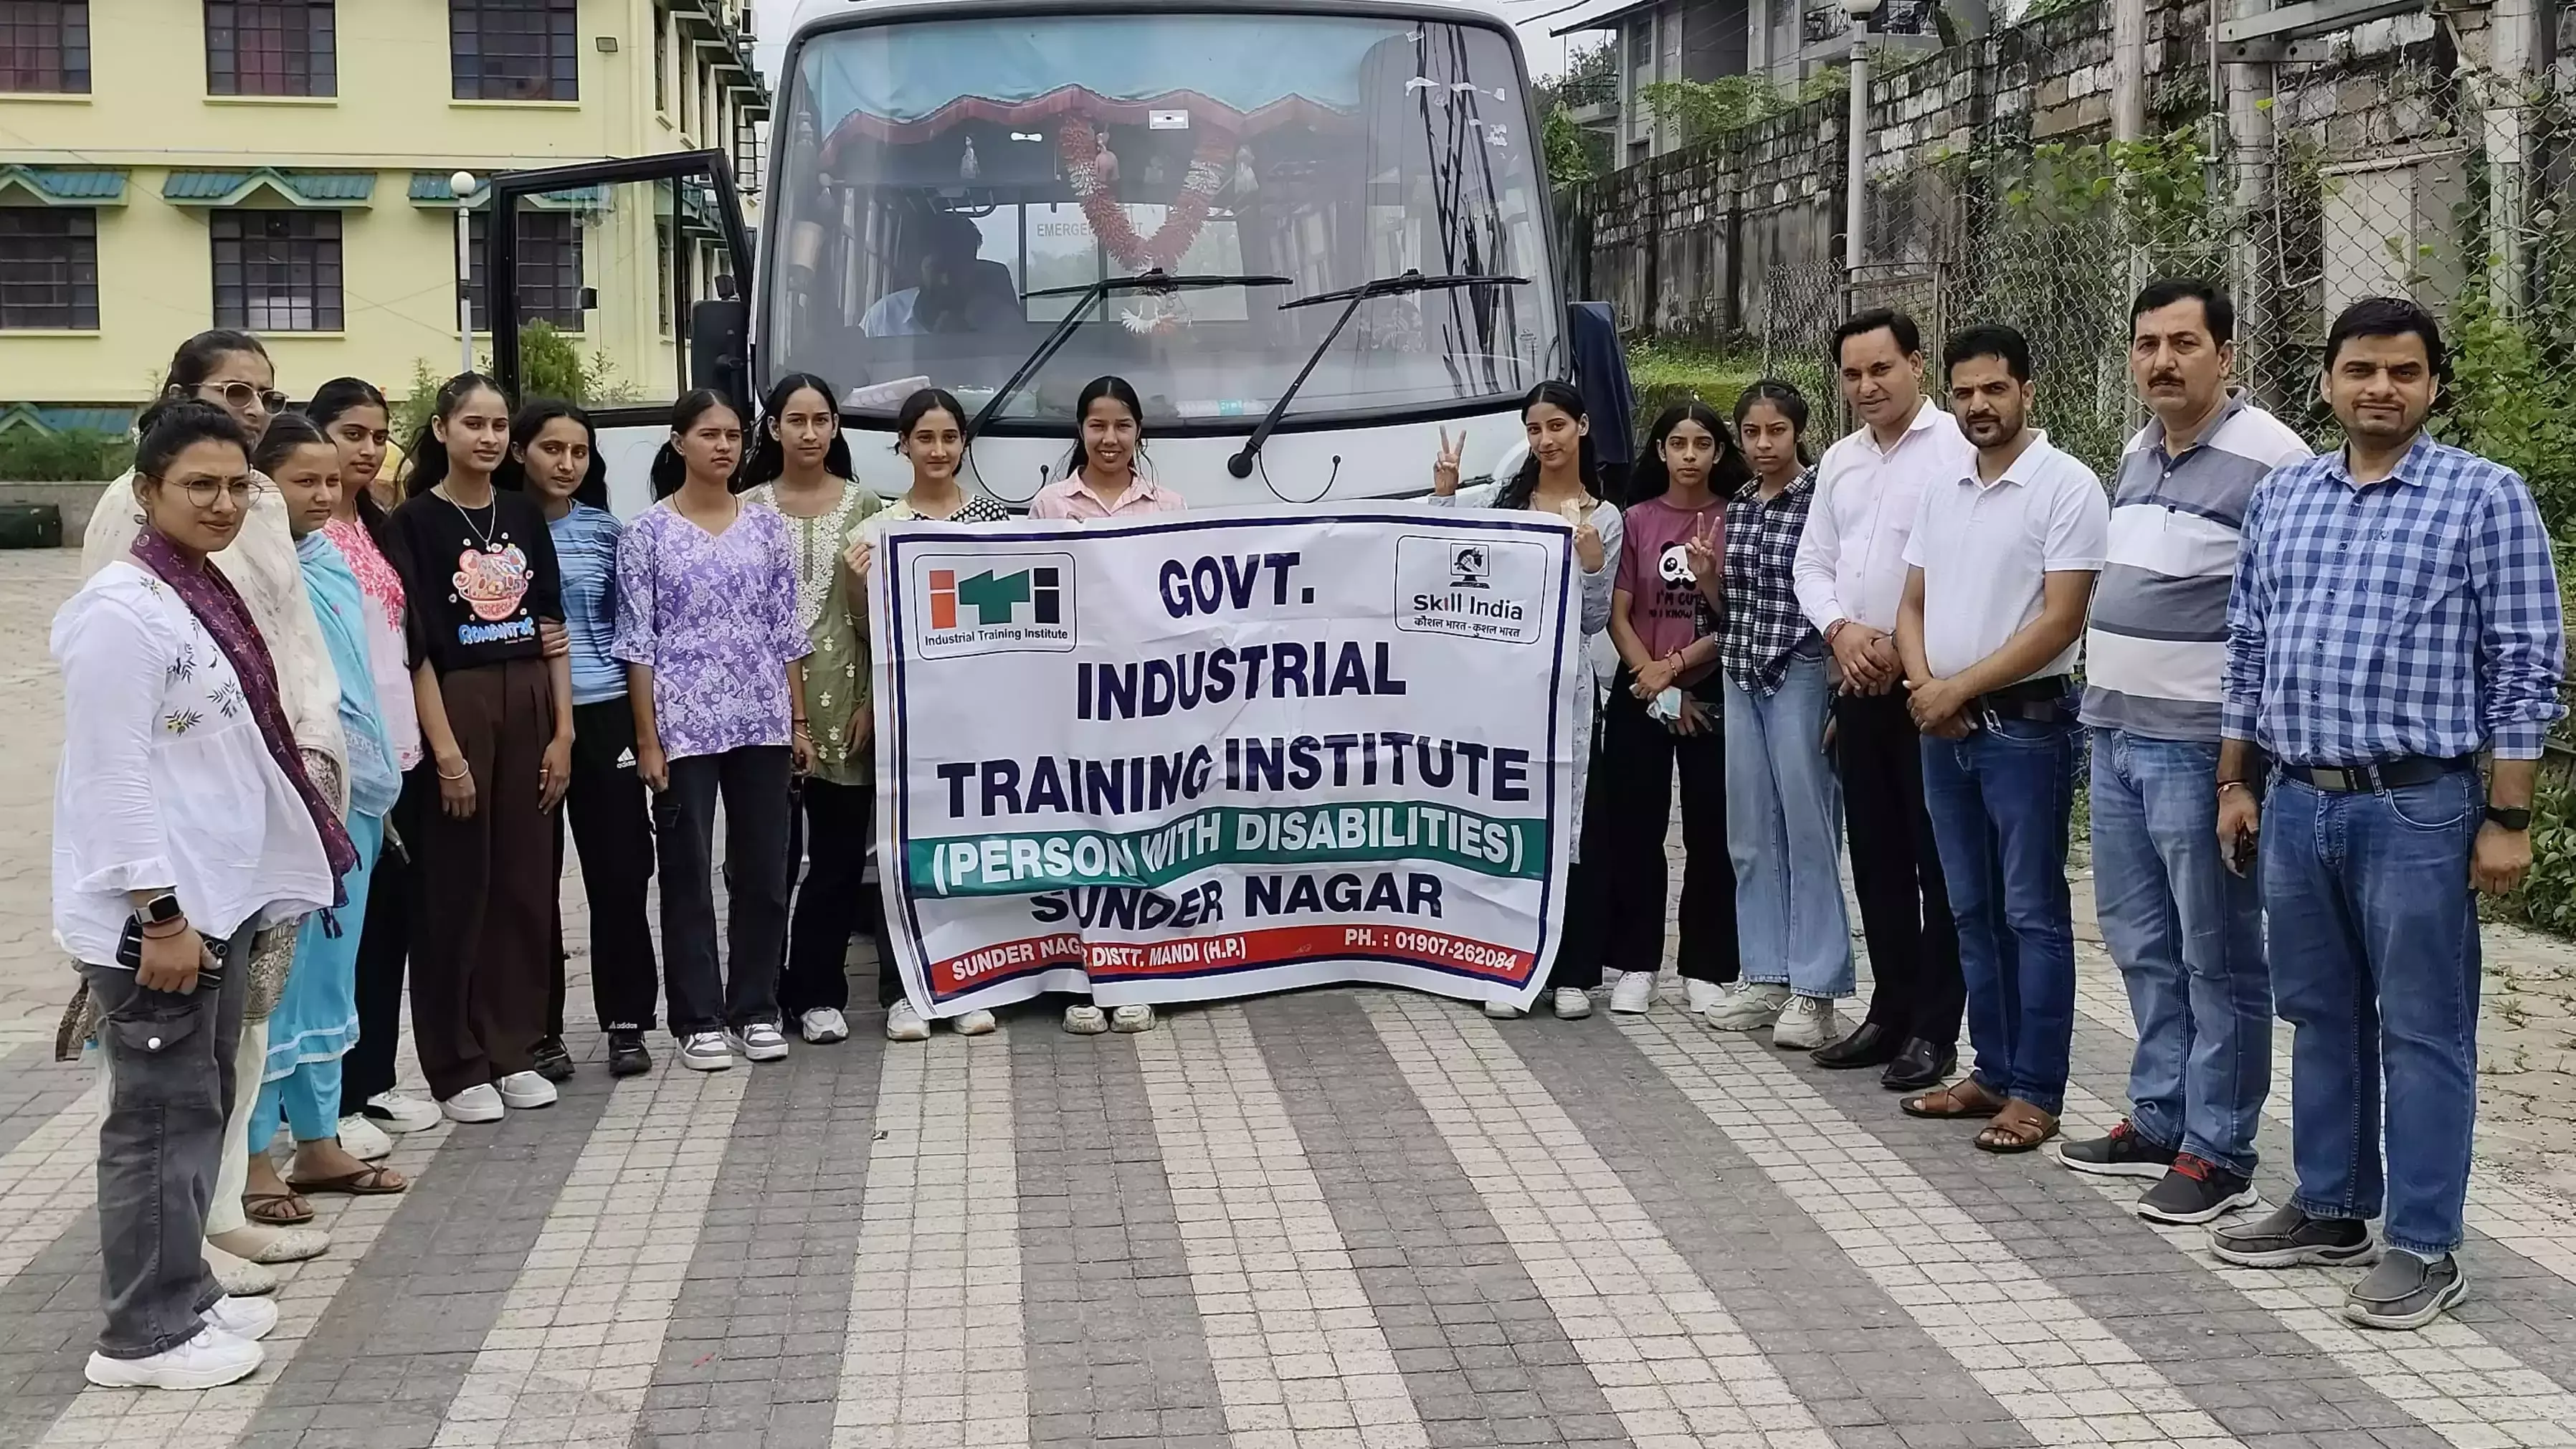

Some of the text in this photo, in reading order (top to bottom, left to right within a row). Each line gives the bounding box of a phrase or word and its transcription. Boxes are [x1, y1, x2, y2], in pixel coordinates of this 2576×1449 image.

[1037, 223, 1093, 237] EMERGE
[1159, 551, 1315, 619] GOVT.
[1413, 592, 1523, 621] Skill India
[1414, 615, 1444, 627] कौशल
[1445, 621, 1466, 631] भारत
[1473, 624, 1497, 637] कुशल
[1499, 627, 1521, 637] भारत
[1665, 609, 1693, 619] KNOW
[925, 628, 1068, 646] Industrial Training Institute
[1077, 641, 1407, 721] INDUSTRIAL
[936, 731, 1529, 818] TRAINING INSTITUTE
[933, 806, 1524, 895] (PERSON WITH DISABILITIES)
[1030, 872, 1443, 931] SUNDER NAGAR
[953, 943, 1035, 981] SUNDER
[1149, 942, 1199, 966] MANDI
[1204, 937, 1247, 964] (H.P.)
[1344, 928, 1377, 946] PH.
[1395, 931, 1518, 971] 01907-262084
